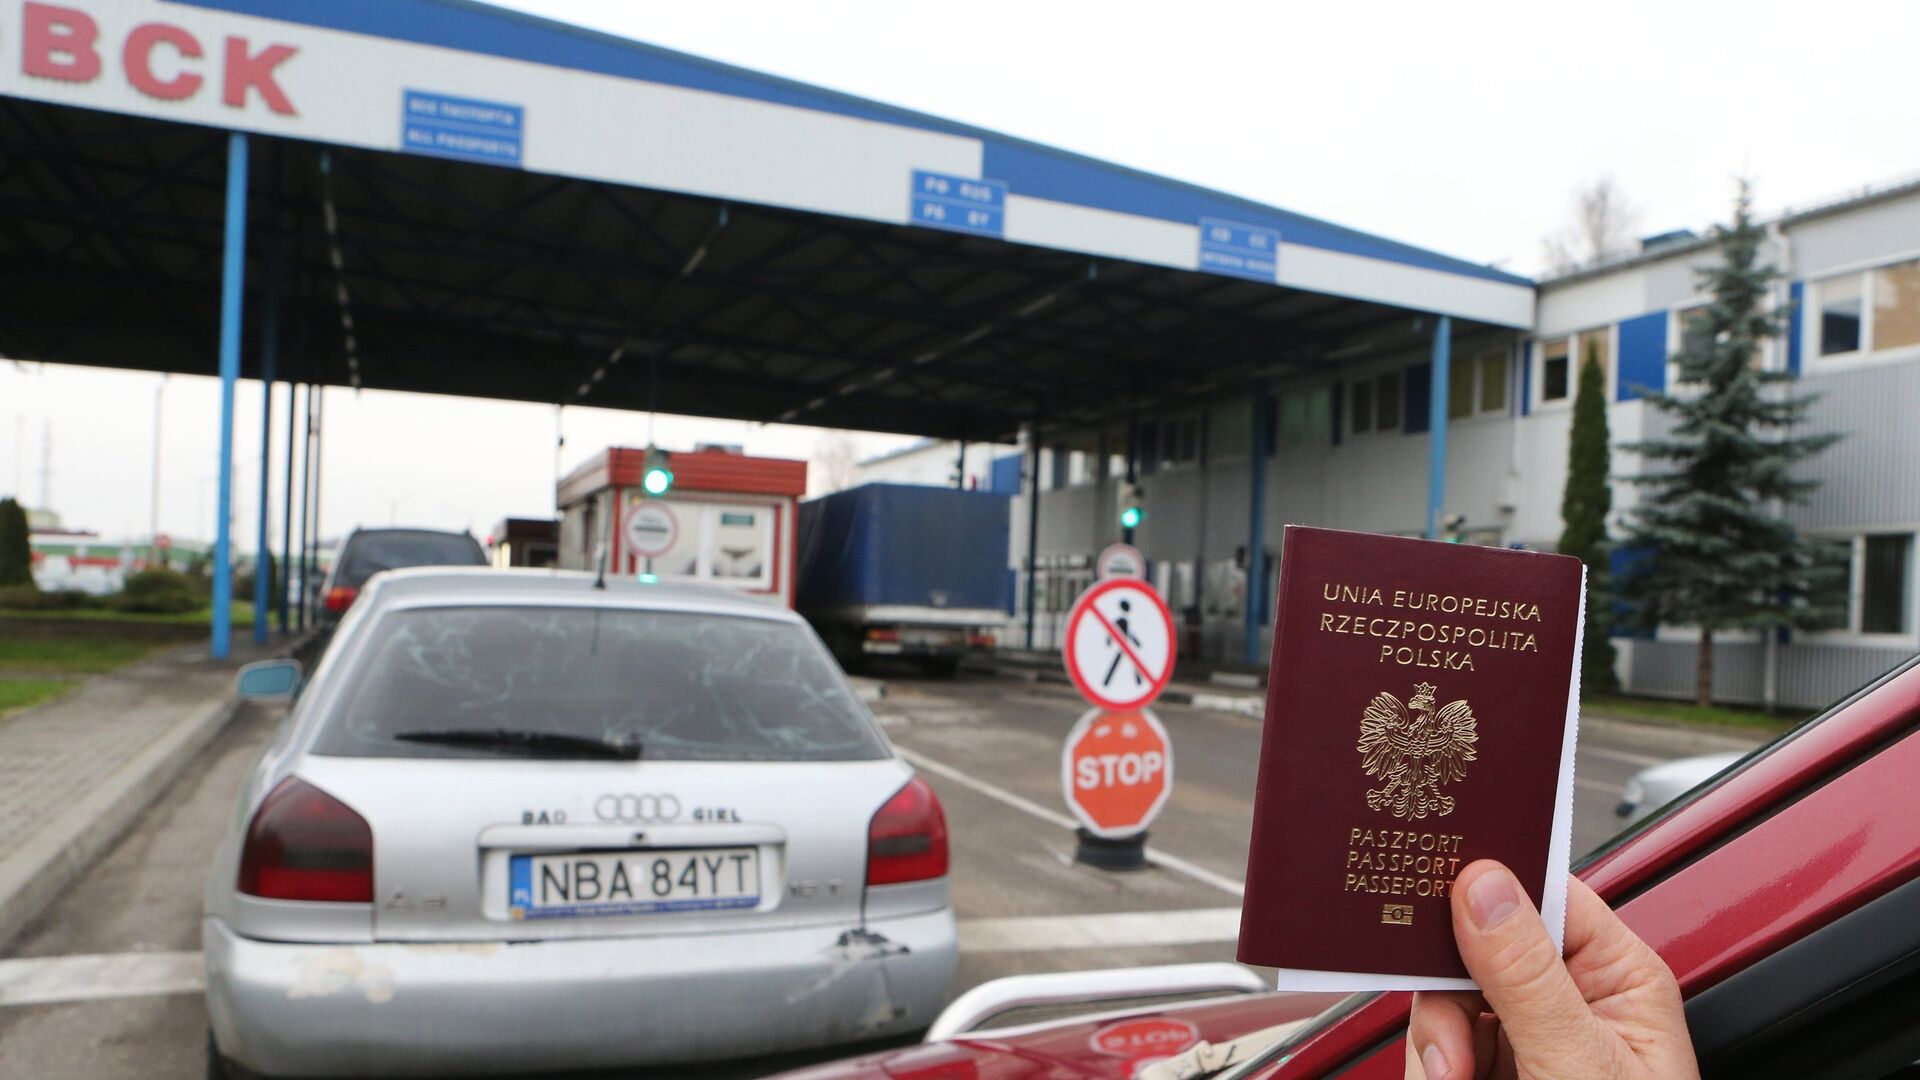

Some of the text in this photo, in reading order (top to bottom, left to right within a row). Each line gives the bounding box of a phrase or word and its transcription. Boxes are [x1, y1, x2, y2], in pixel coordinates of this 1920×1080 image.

[1323, 583, 1542, 622] UNIA EUROPEJSKA
[1319, 612, 1538, 653] RZECZPOSPOLITA
[1379, 645, 1475, 672] POLSKA
[1076, 750, 1163, 790] STOP
[522, 807, 742, 825] BAD GIRL
[1349, 828, 1463, 853] PASZPORT
[541, 854, 750, 901] NBA 84YT
[1346, 851, 1460, 876] PASSPORT
